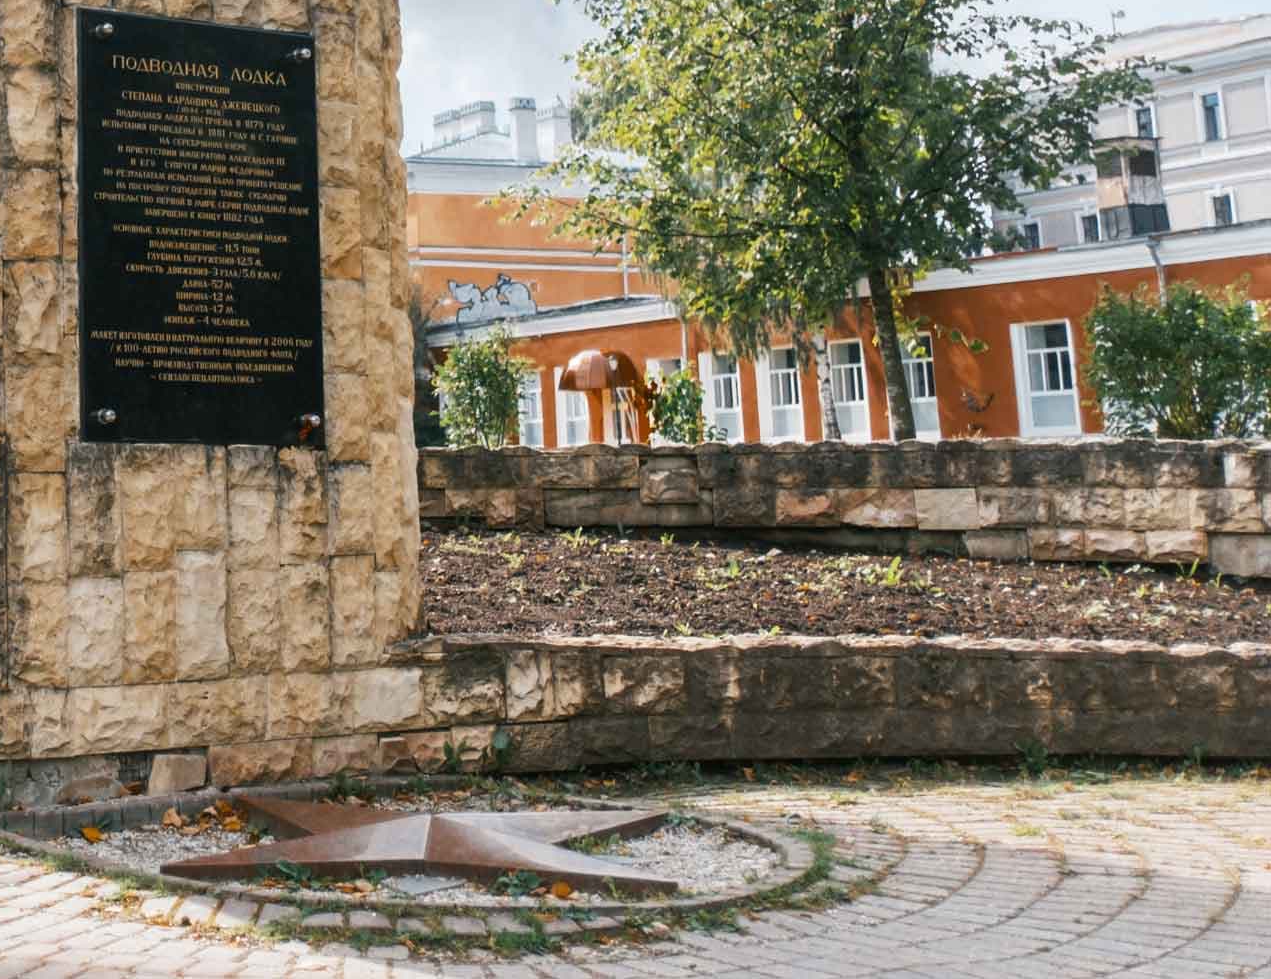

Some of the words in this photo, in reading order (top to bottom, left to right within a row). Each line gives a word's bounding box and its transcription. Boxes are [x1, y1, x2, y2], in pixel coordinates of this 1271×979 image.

[112, 53, 219, 80] ПОДВОДНАЯ
[231, 66, 287, 87] ЛОДКА
[121, 89, 162, 103] СТЕПАНА
